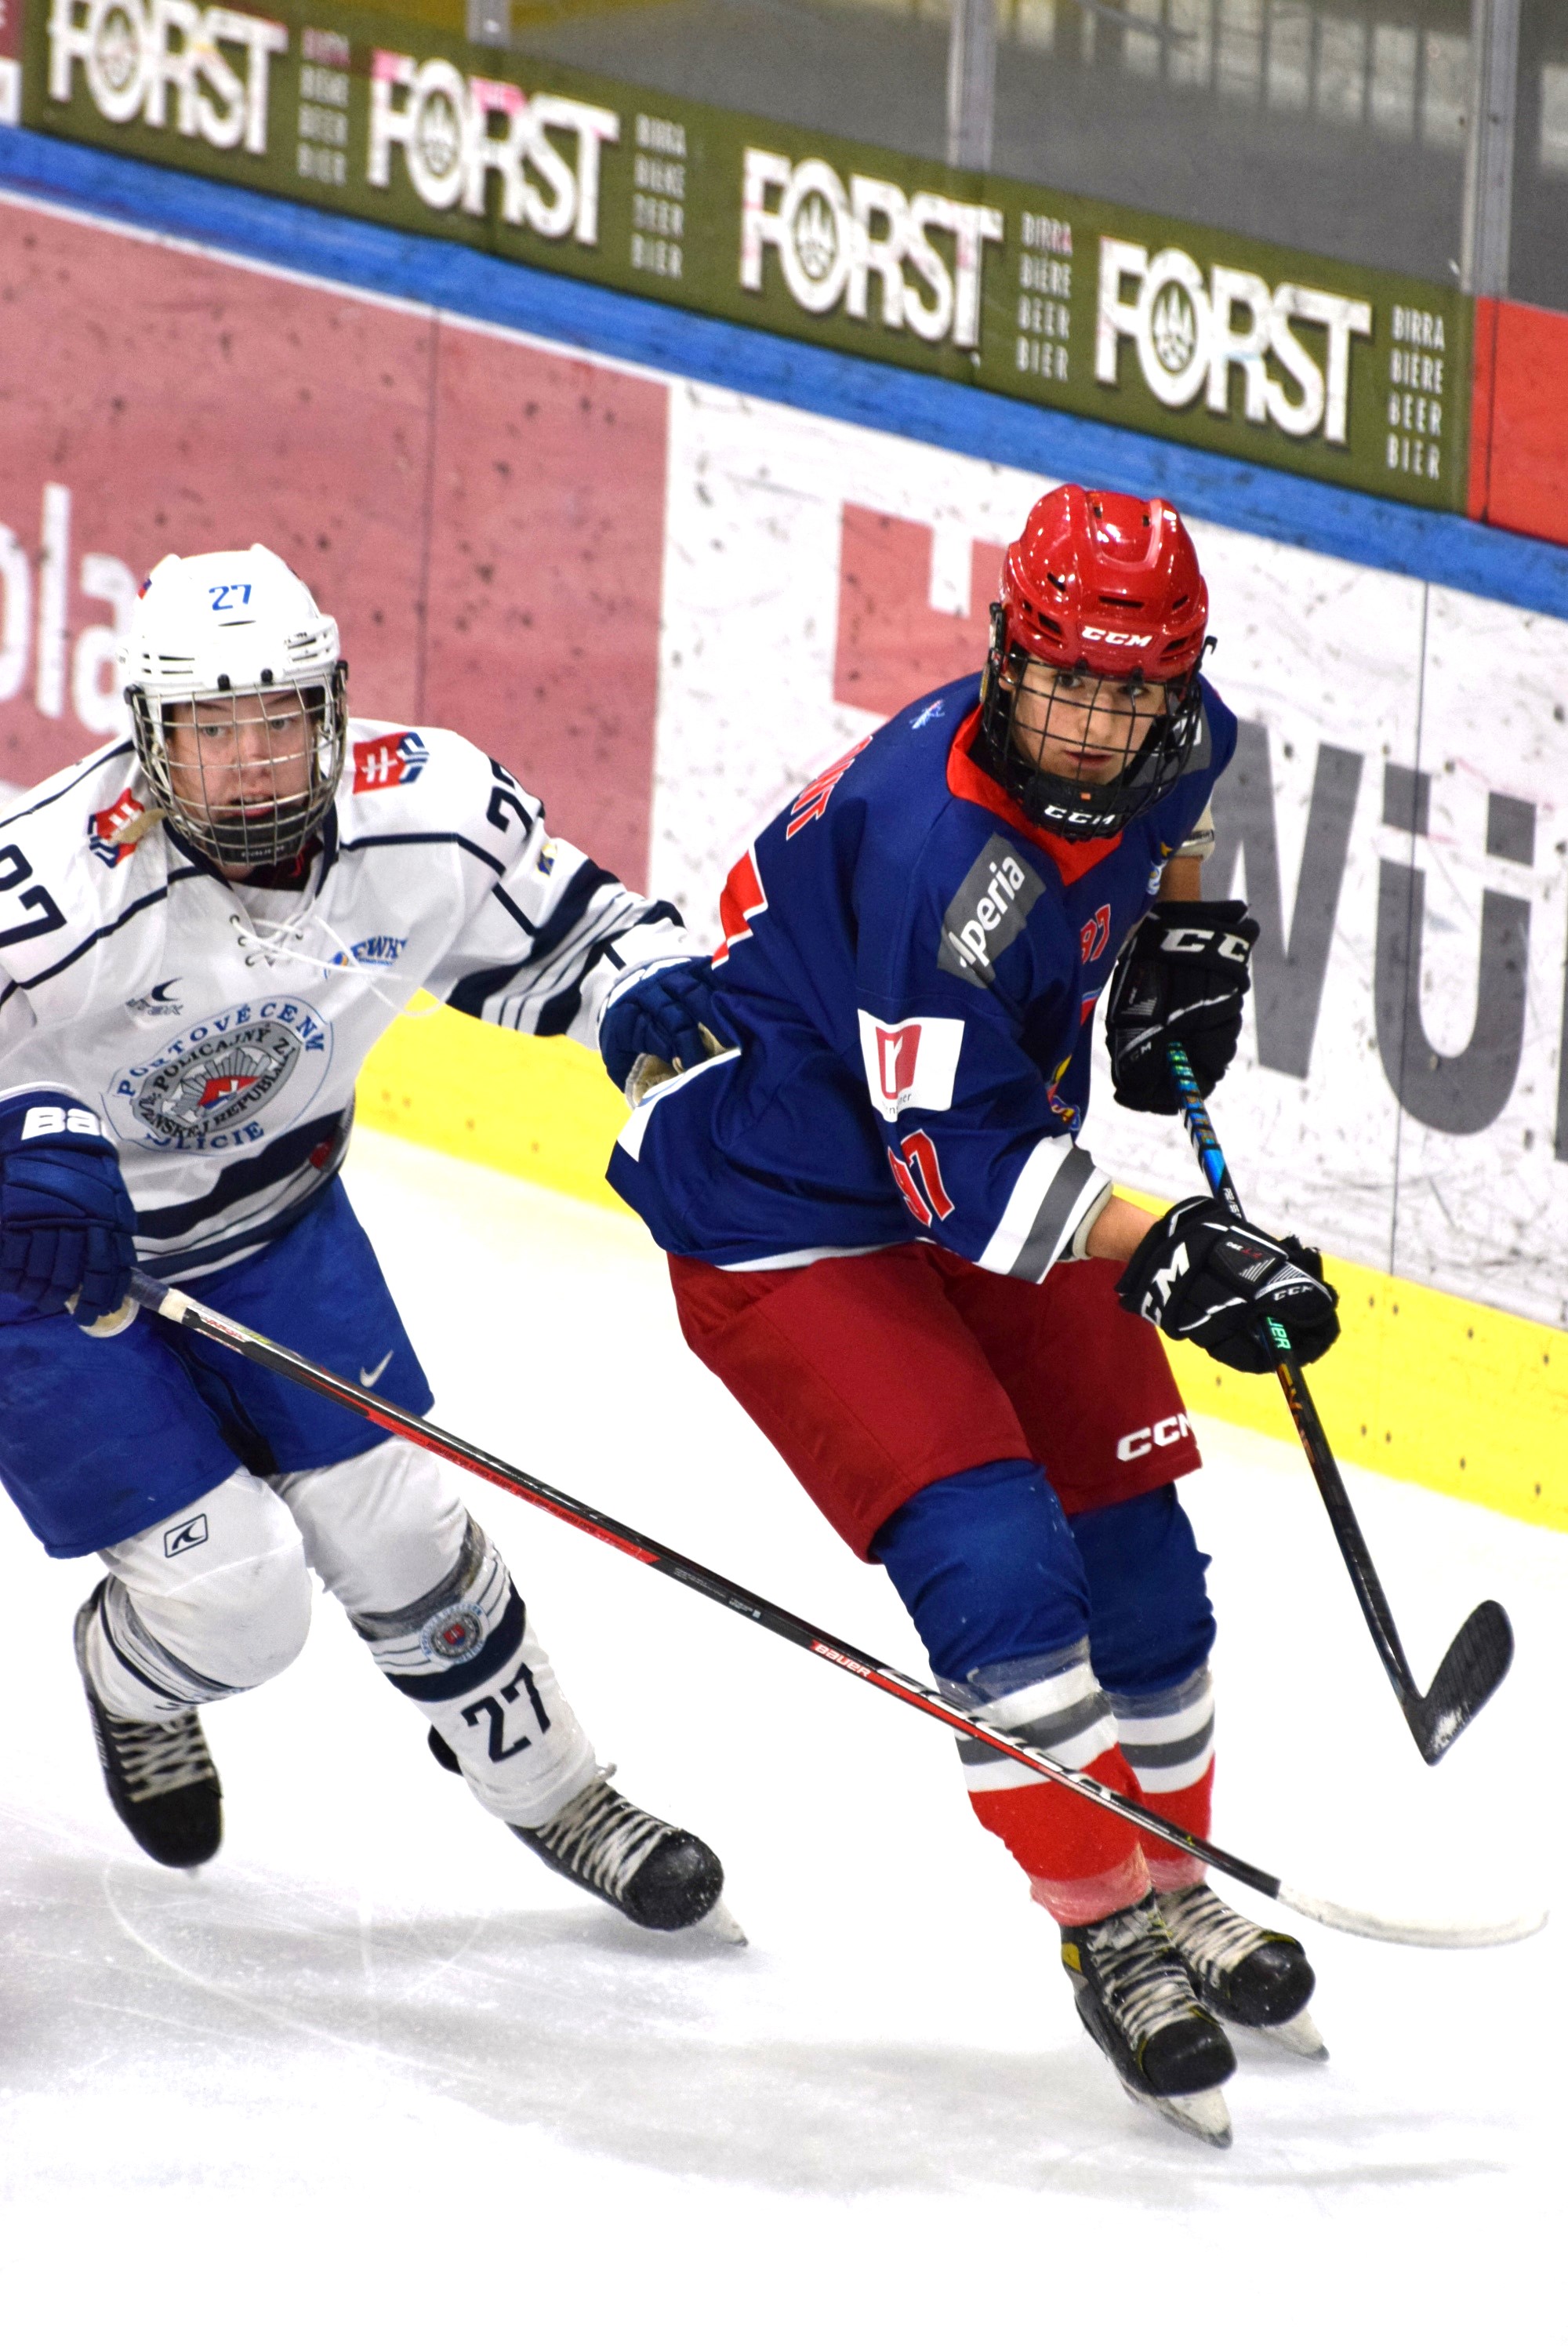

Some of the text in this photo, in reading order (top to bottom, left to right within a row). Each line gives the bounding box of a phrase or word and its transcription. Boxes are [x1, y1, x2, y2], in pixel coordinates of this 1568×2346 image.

[50, 0, 288, 154] FORST
[368, 49, 619, 247] FORST
[739, 147, 1004, 348] FORST
[1021, 211, 1073, 256] BIRRA
[1018, 295, 1070, 340] BEER
[1095, 236, 1372, 445] FORST
[1392, 303, 1445, 351] BIRRA
[1017, 336, 1069, 383] BIER
[1388, 391, 1442, 437] BEER
[1386, 433, 1440, 481] BIER
[209, 583, 252, 611] 27
[1081, 626, 1152, 648] CCM
[1044, 804, 1116, 826] CCM
[1160, 928, 1250, 963] CC
[1198, 712, 1568, 1162] WÜ
[460, 1661, 552, 1763] 27
